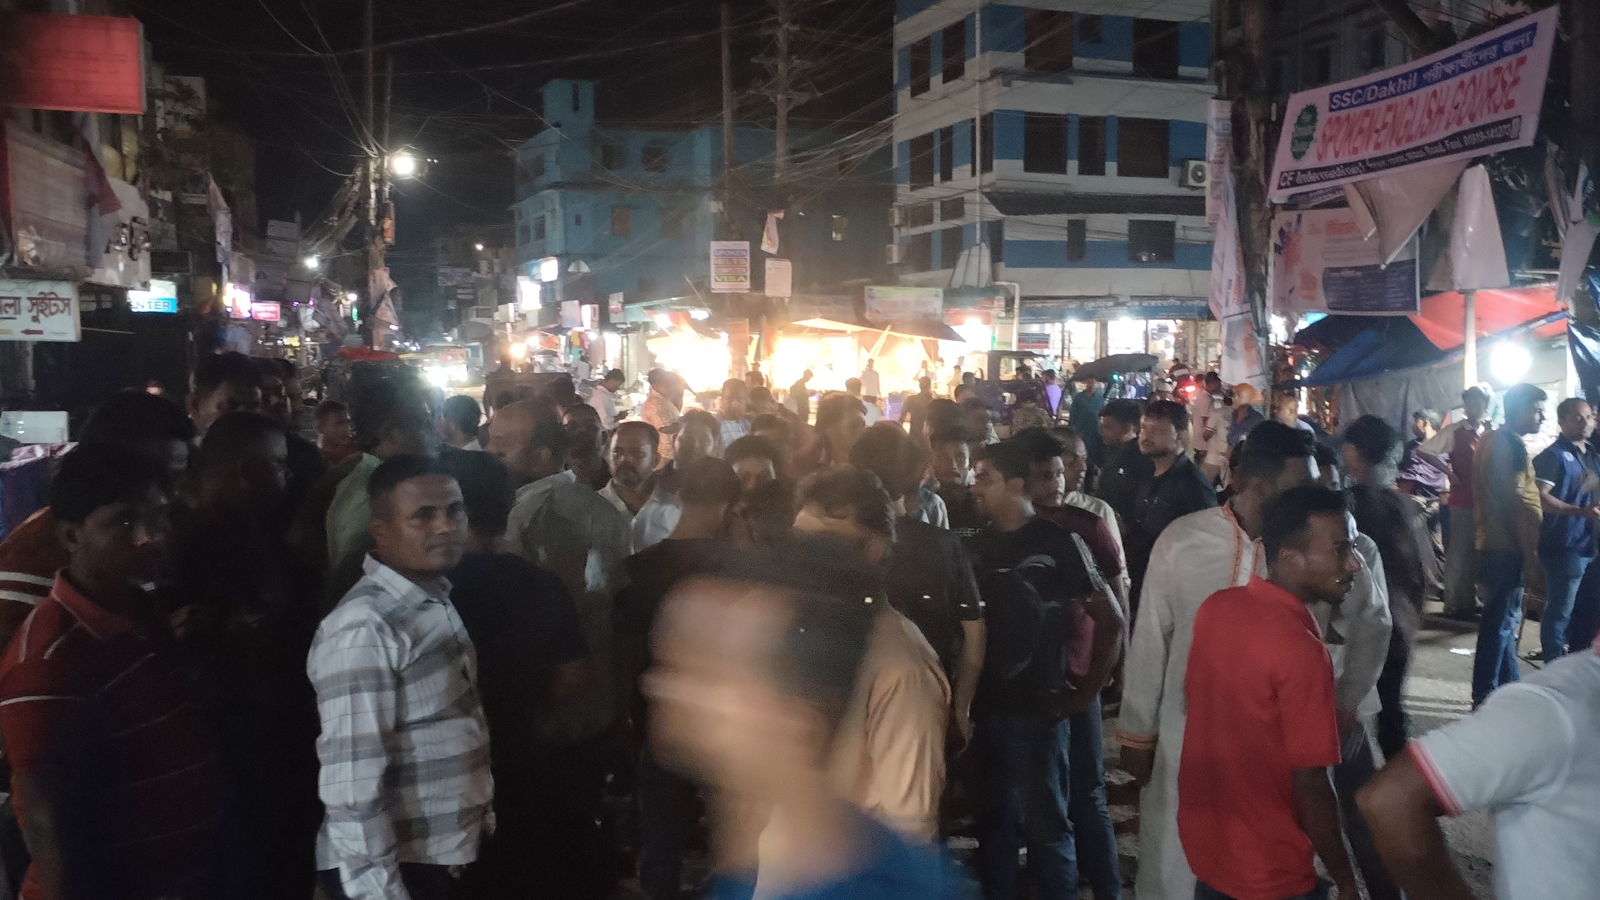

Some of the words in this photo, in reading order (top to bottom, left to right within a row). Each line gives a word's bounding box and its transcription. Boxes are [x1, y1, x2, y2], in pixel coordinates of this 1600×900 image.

[1316, 106, 1383, 161] SPOKEN
[1373, 83, 1450, 150] ENGLISH
[1444, 55, 1528, 131] COURSE
[1330, 73, 1418, 110] SSC/Dakhil
[714, 249, 747, 257] SPOKEN
